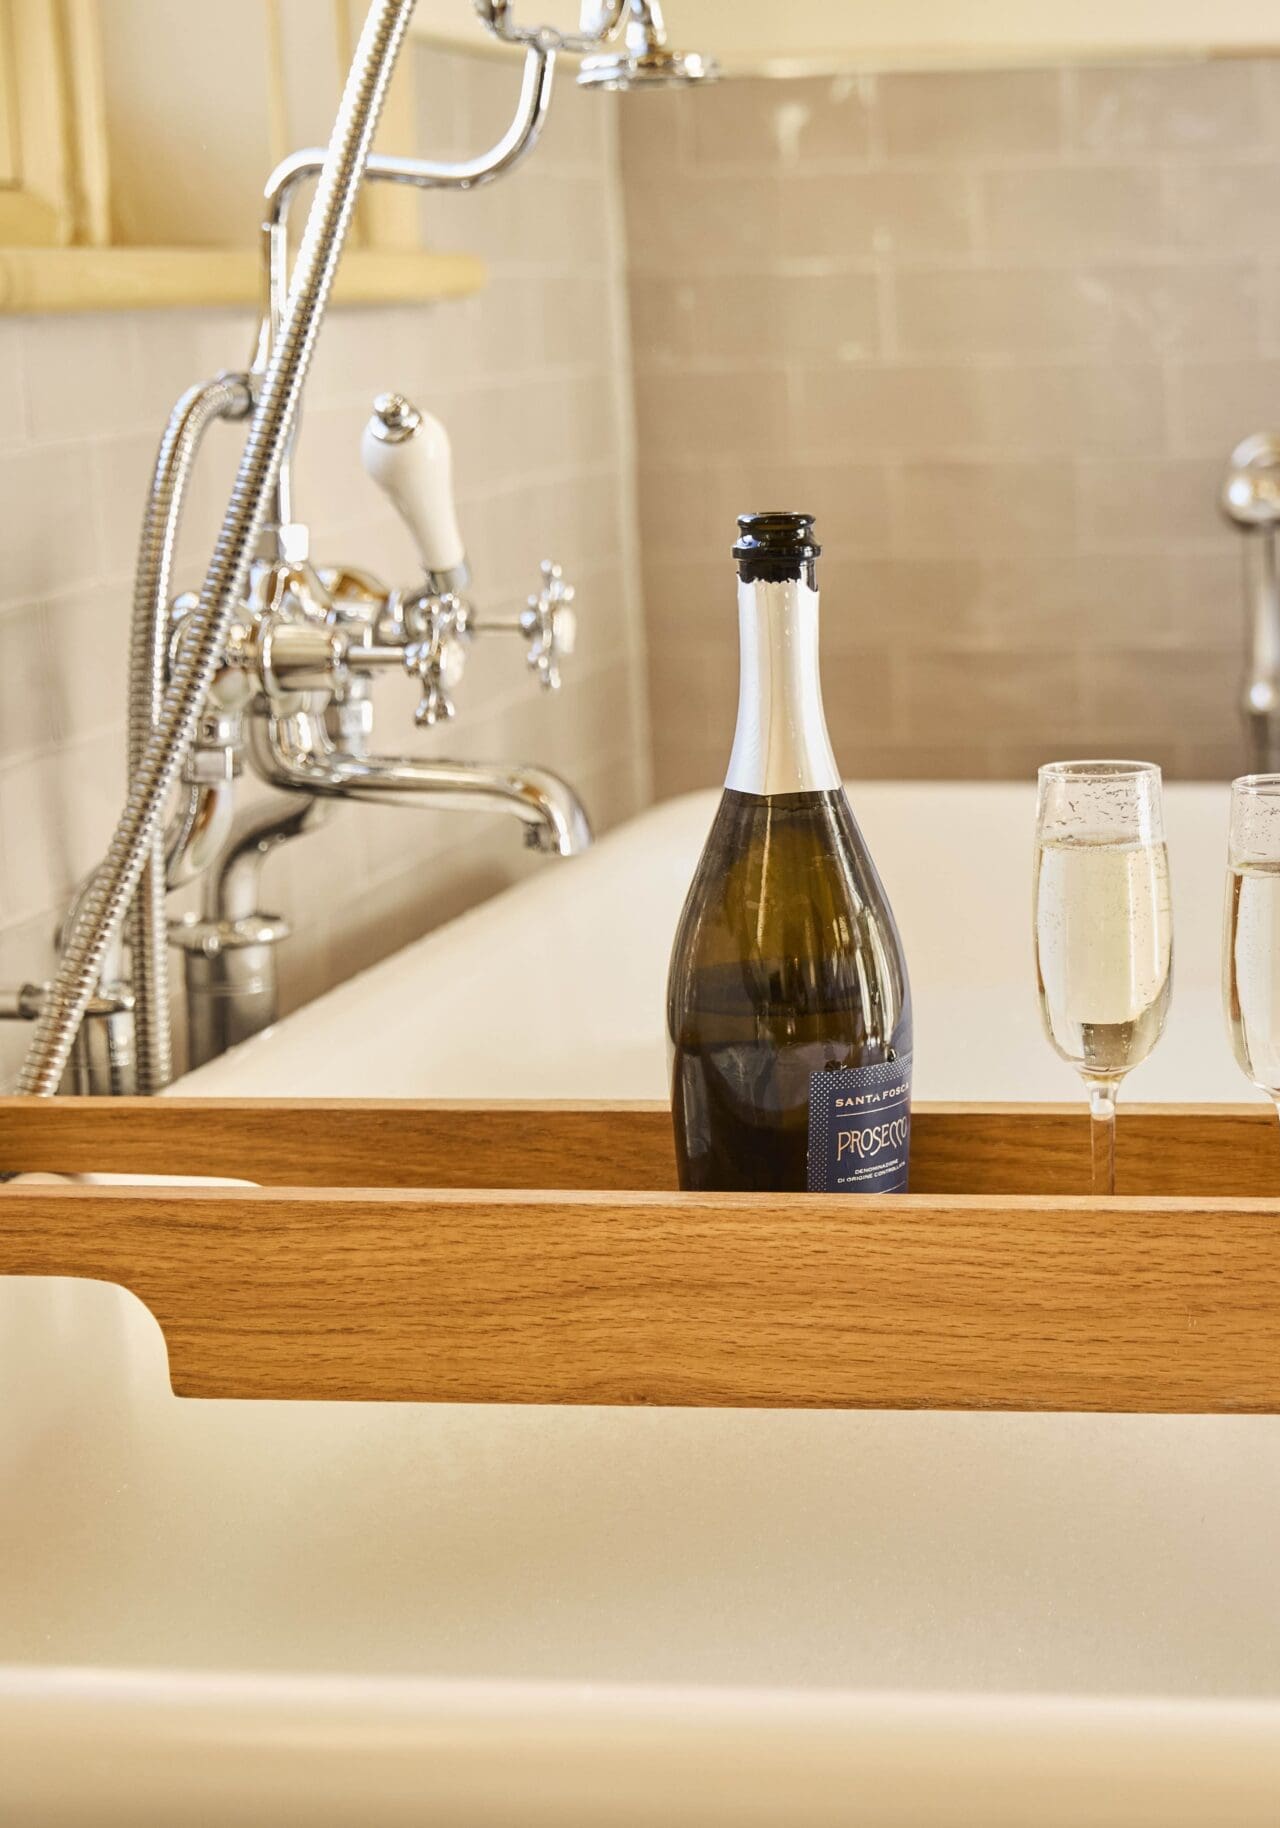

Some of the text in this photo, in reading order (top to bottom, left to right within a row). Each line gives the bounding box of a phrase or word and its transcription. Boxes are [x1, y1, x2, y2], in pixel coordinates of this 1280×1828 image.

[835, 1093, 880, 1108] SANTA
[836, 1116, 908, 1161] PROSECCO
[846, 1173, 873, 1183] ORIGINE
